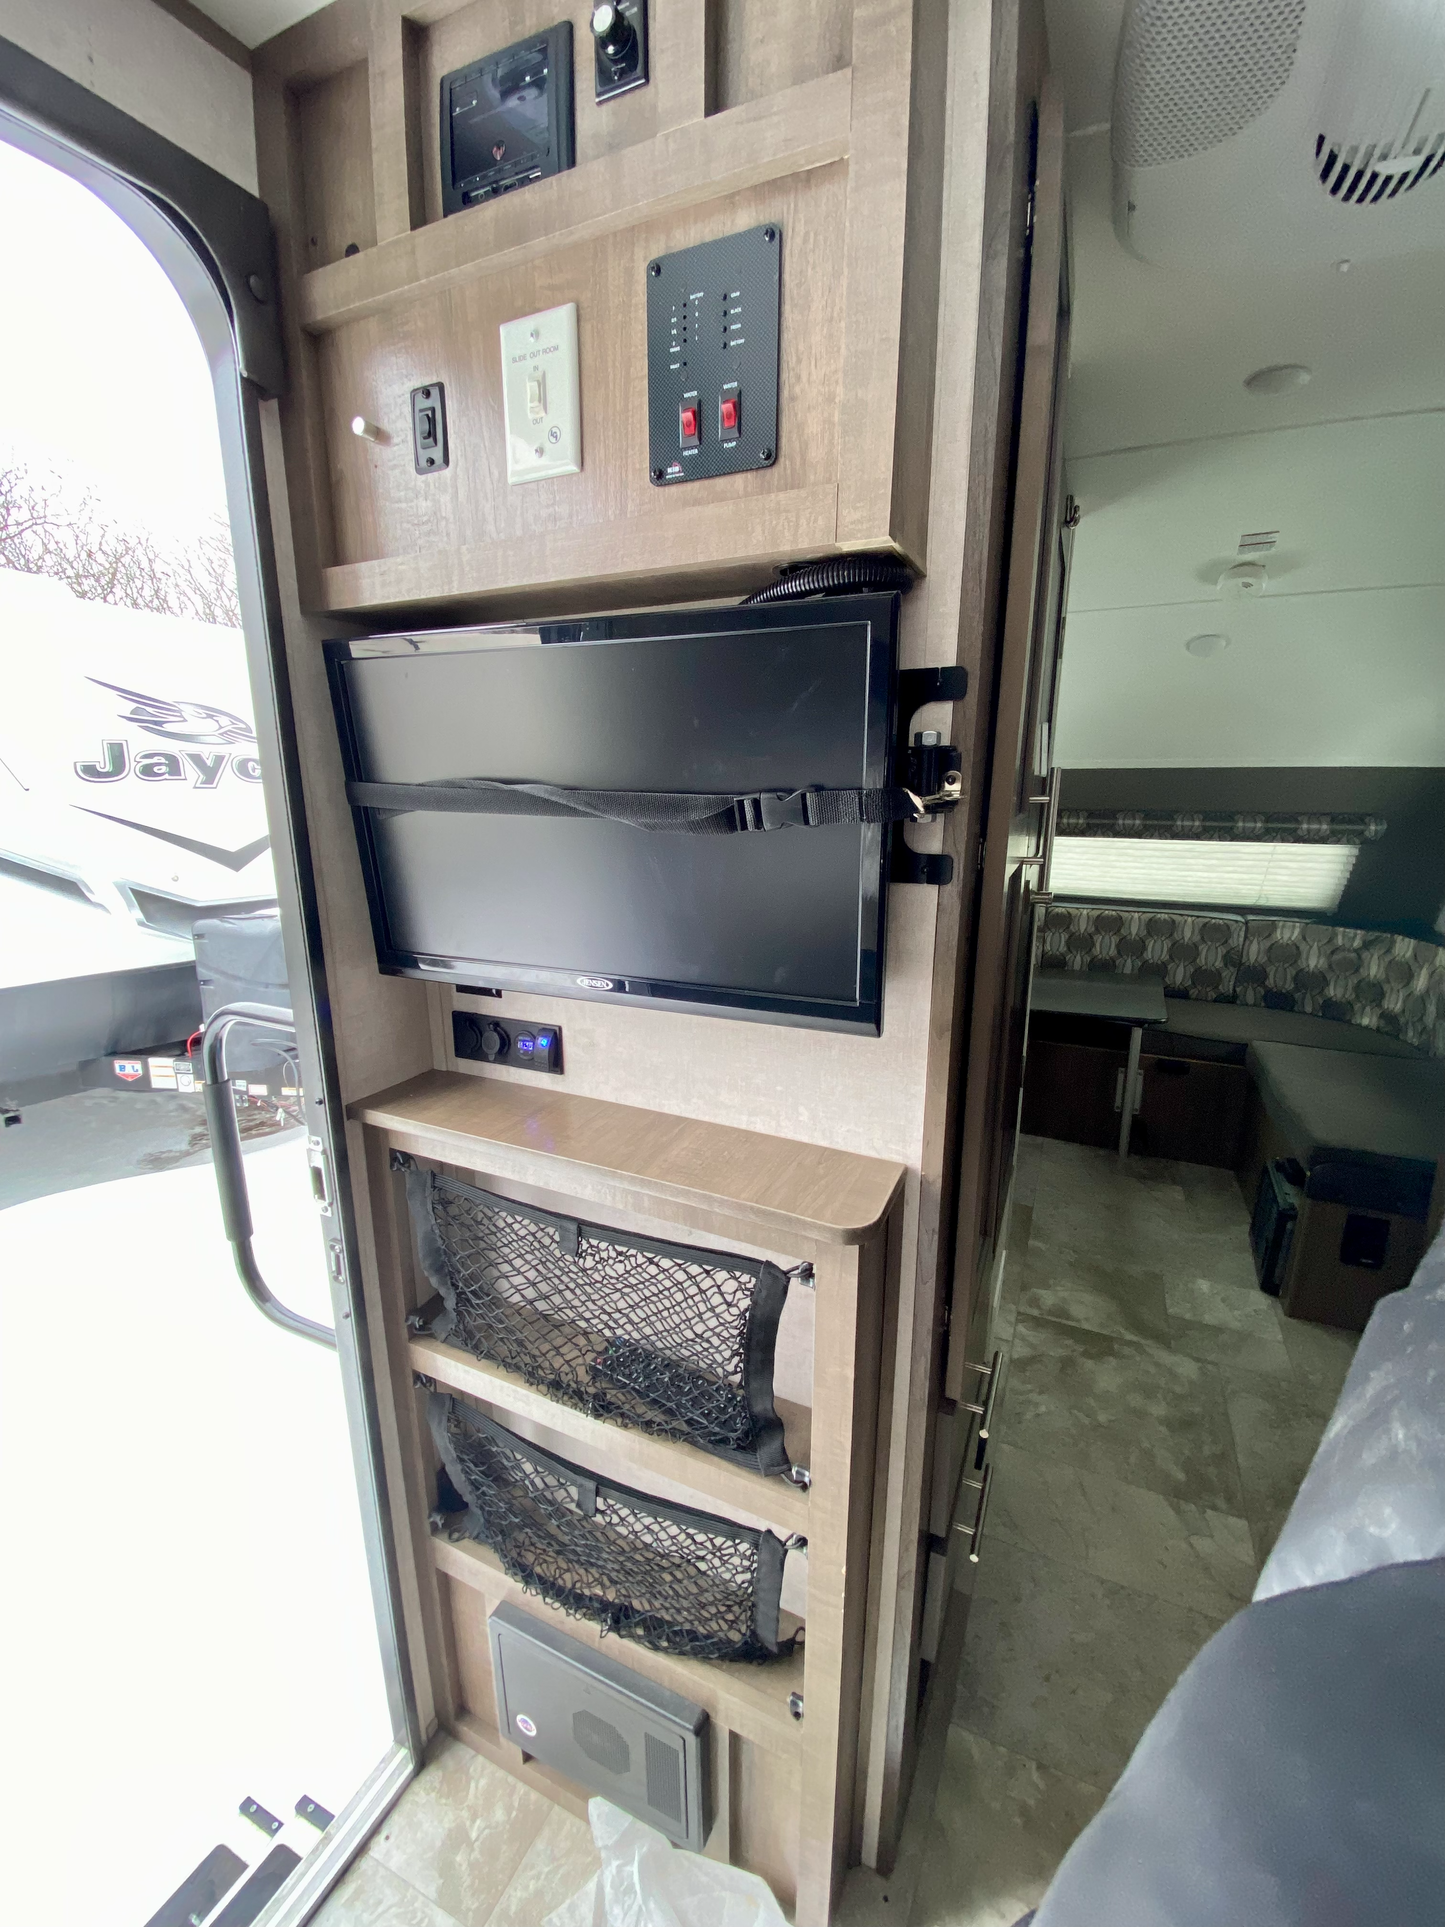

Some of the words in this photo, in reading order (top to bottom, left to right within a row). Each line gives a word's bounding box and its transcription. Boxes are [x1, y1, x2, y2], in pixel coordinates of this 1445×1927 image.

[512, 353, 527, 364] SLIDE
[529, 349, 542, 359] OUT
[541, 345, 560, 355] ROOM
[532, 417, 544, 426] OUT
[723, 441, 737, 449] PUMP
[682, 448, 698, 456] HEATER
[581, 978, 608, 989] JENSEN
